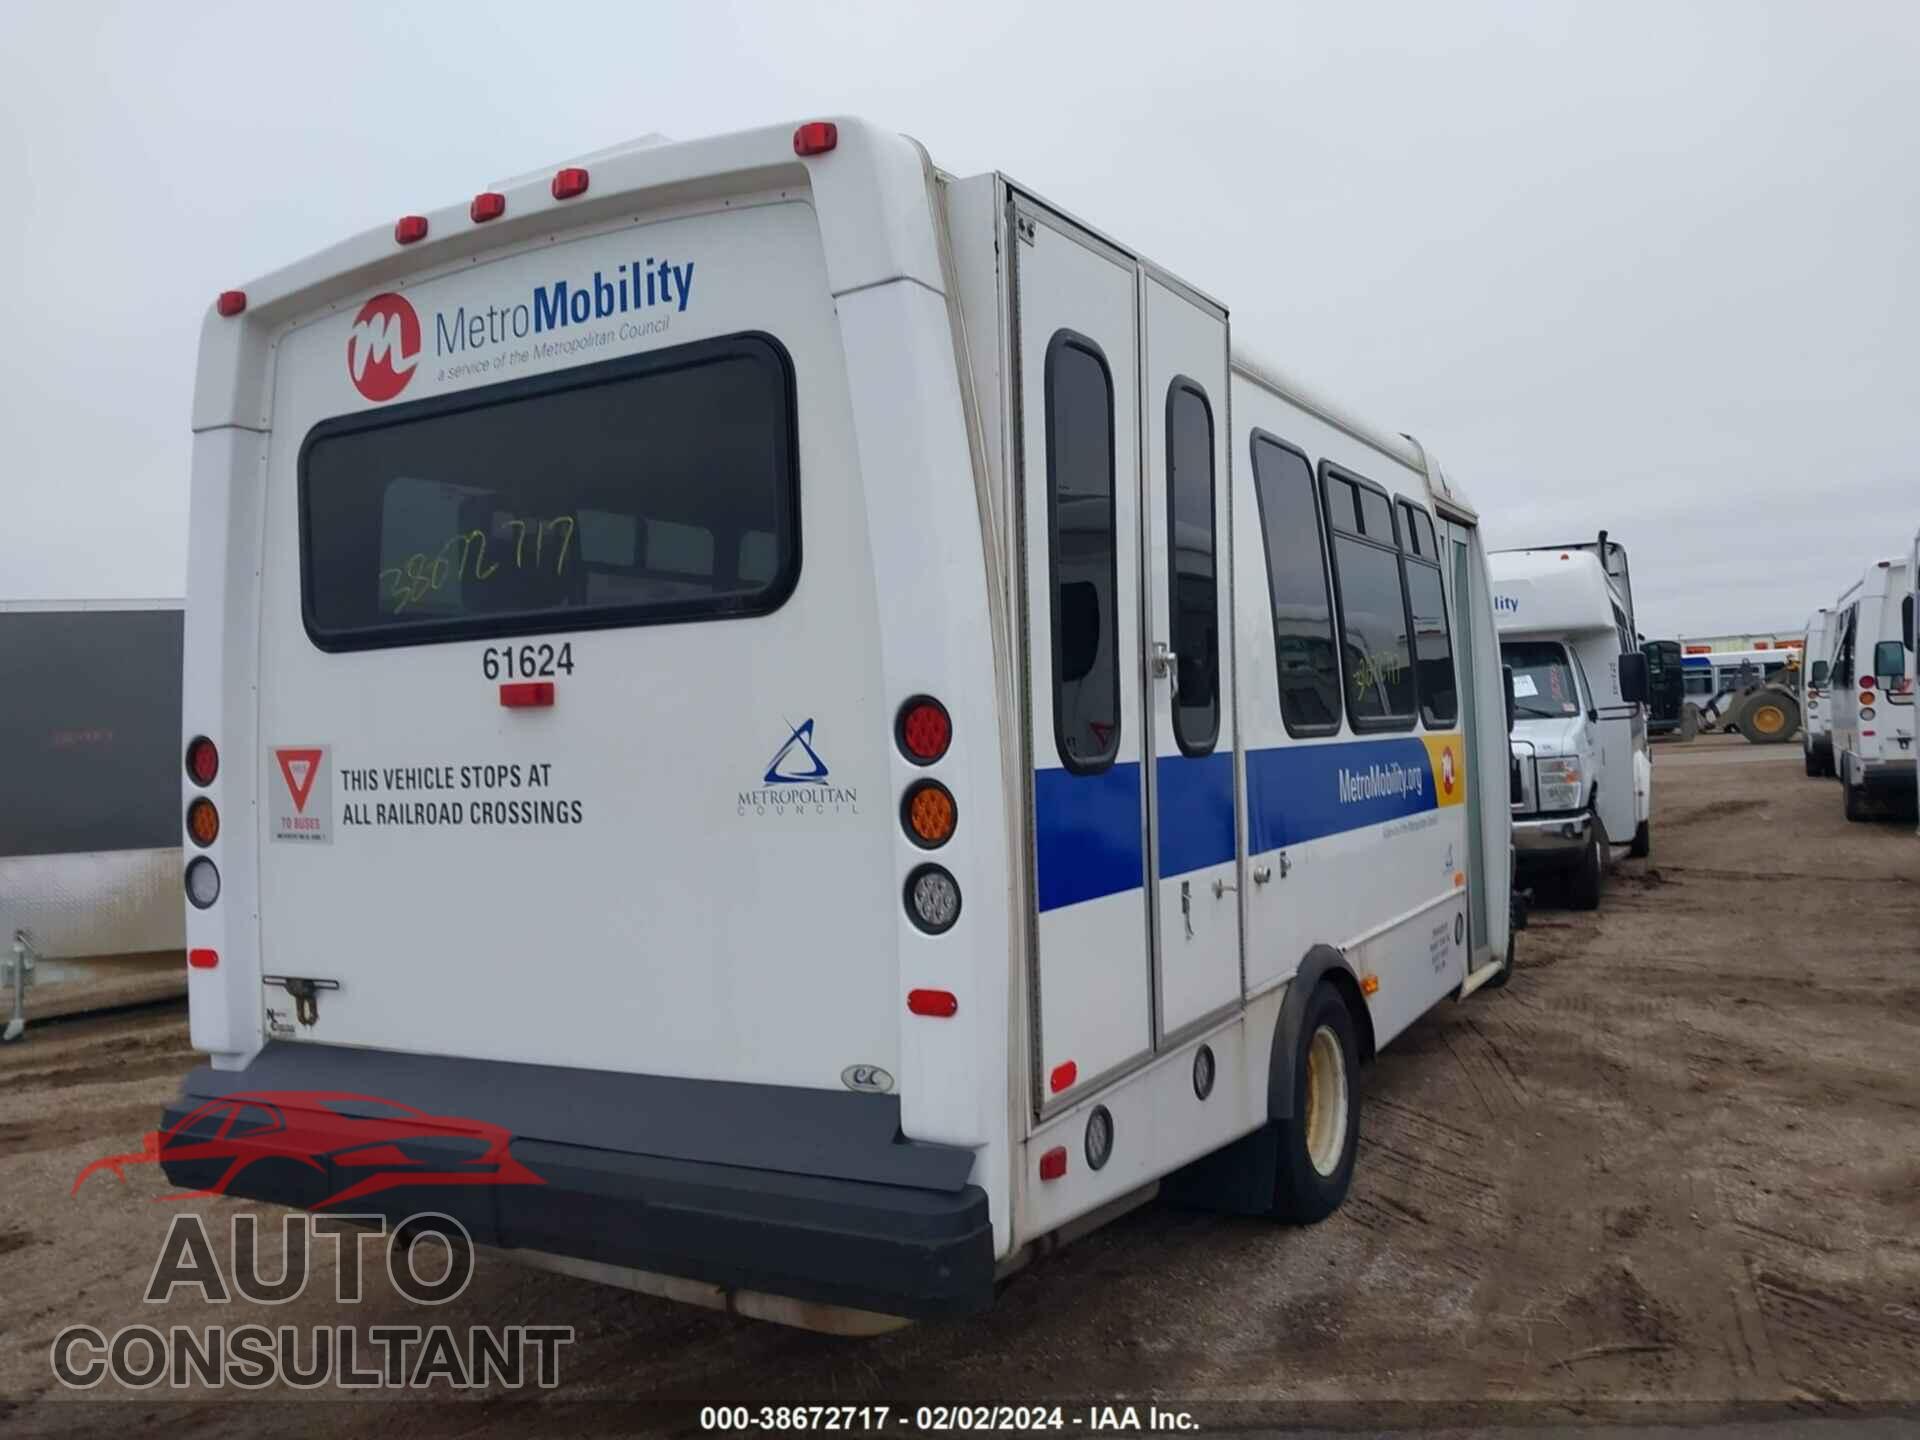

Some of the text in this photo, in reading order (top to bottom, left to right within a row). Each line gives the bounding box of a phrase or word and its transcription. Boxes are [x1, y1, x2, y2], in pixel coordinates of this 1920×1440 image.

[436, 257, 694, 357] MetroMobility
[448, 358, 489, 381] service
[494, 352, 506, 368] of
[508, 347, 530, 366] the
[533, 329, 616, 360] Metropolitan
[619, 316, 671, 341] Council
[483, 642, 574, 680] 61624
[341, 763, 552, 791] THIS VEHICLE STOPS AT
[1338, 762, 1422, 803] MetroMobility.org
[343, 800, 582, 825] ALL RAILROAD CROSSINGS
[737, 803, 859, 816] COUNCIL
[738, 788, 857, 805] METROPOLITAN
